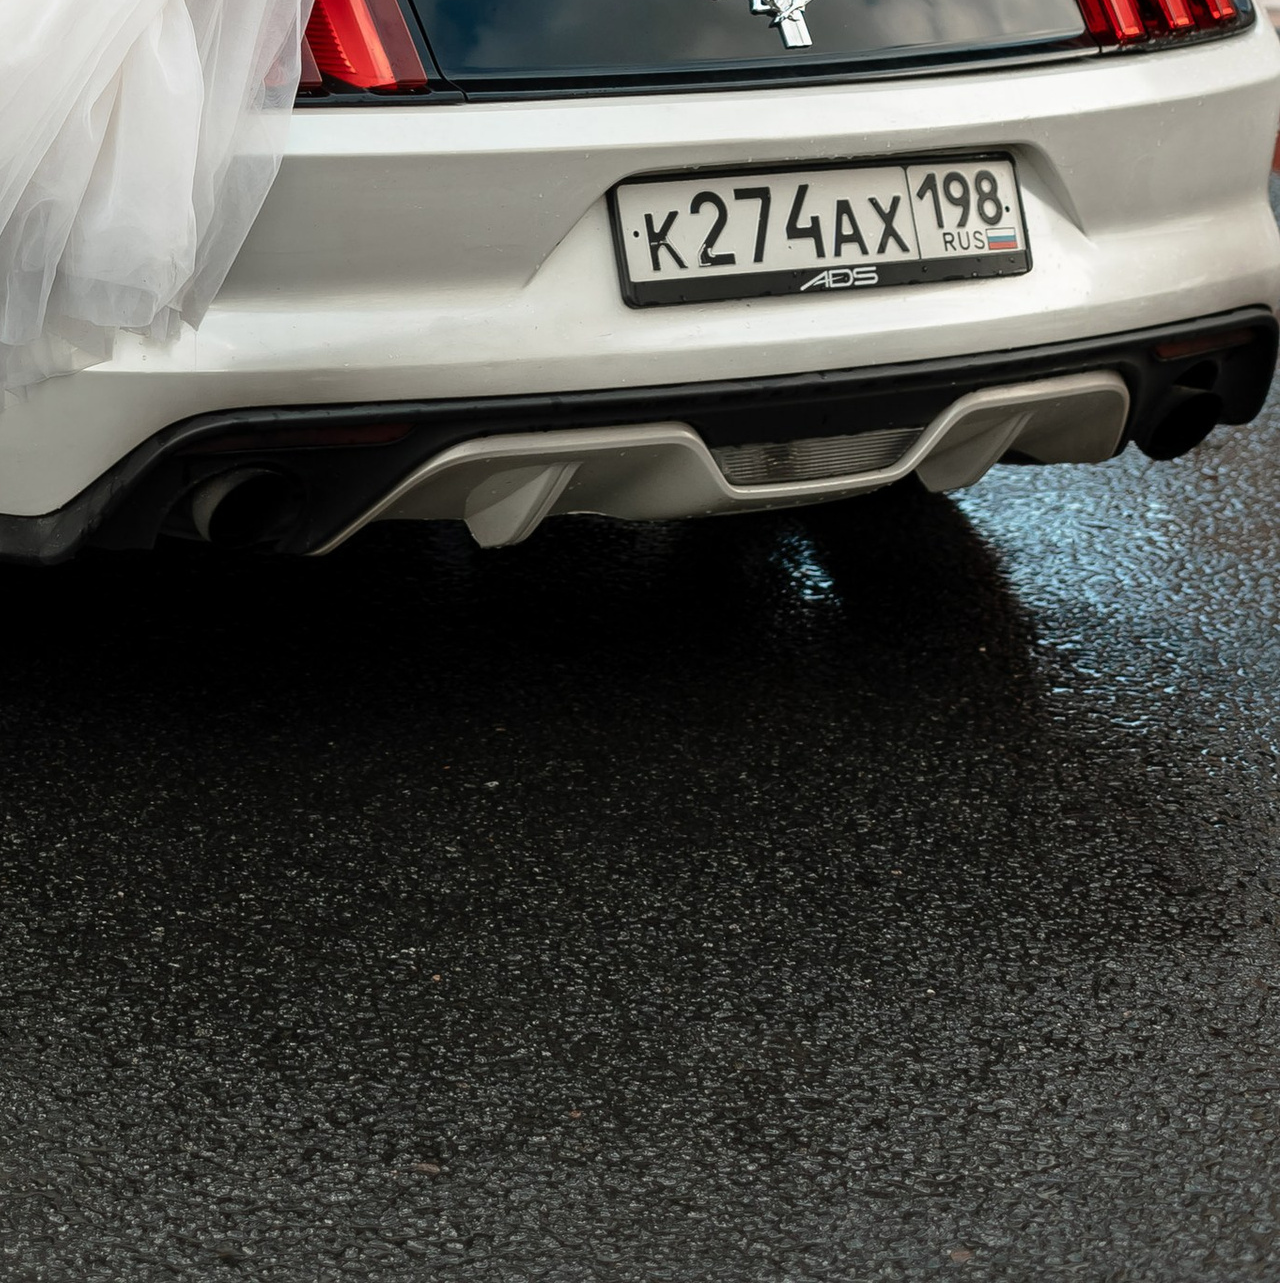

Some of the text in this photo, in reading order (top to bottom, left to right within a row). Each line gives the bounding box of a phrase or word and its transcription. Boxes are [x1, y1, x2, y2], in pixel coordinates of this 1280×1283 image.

[917, 170, 1003, 228] 198
[943, 231, 986, 251] RUS
[800, 266, 878, 291] ADS
